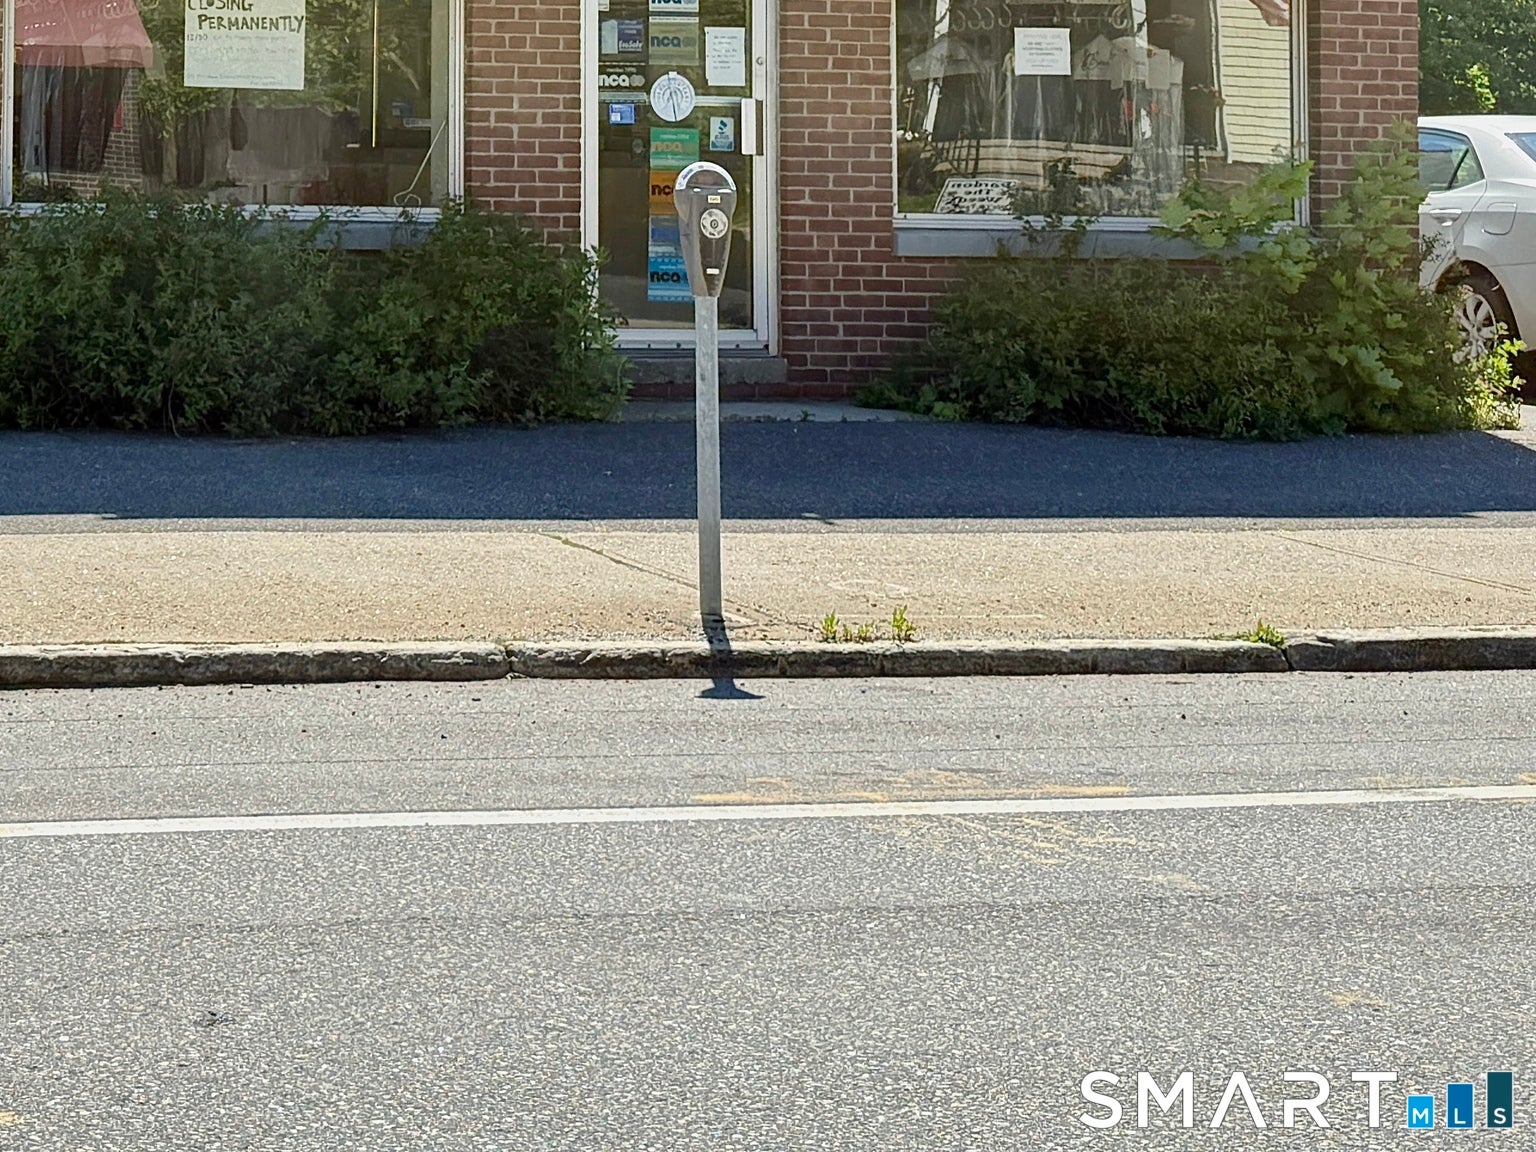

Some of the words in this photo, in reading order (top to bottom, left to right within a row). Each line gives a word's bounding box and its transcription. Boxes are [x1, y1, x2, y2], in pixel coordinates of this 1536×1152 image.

[198, 14, 304, 34] PERMANENTLY
[650, 35, 681, 48] nca
[598, 74, 630, 87] nca
[651, 184, 674, 196] nc
[650, 271, 681, 283] nca
